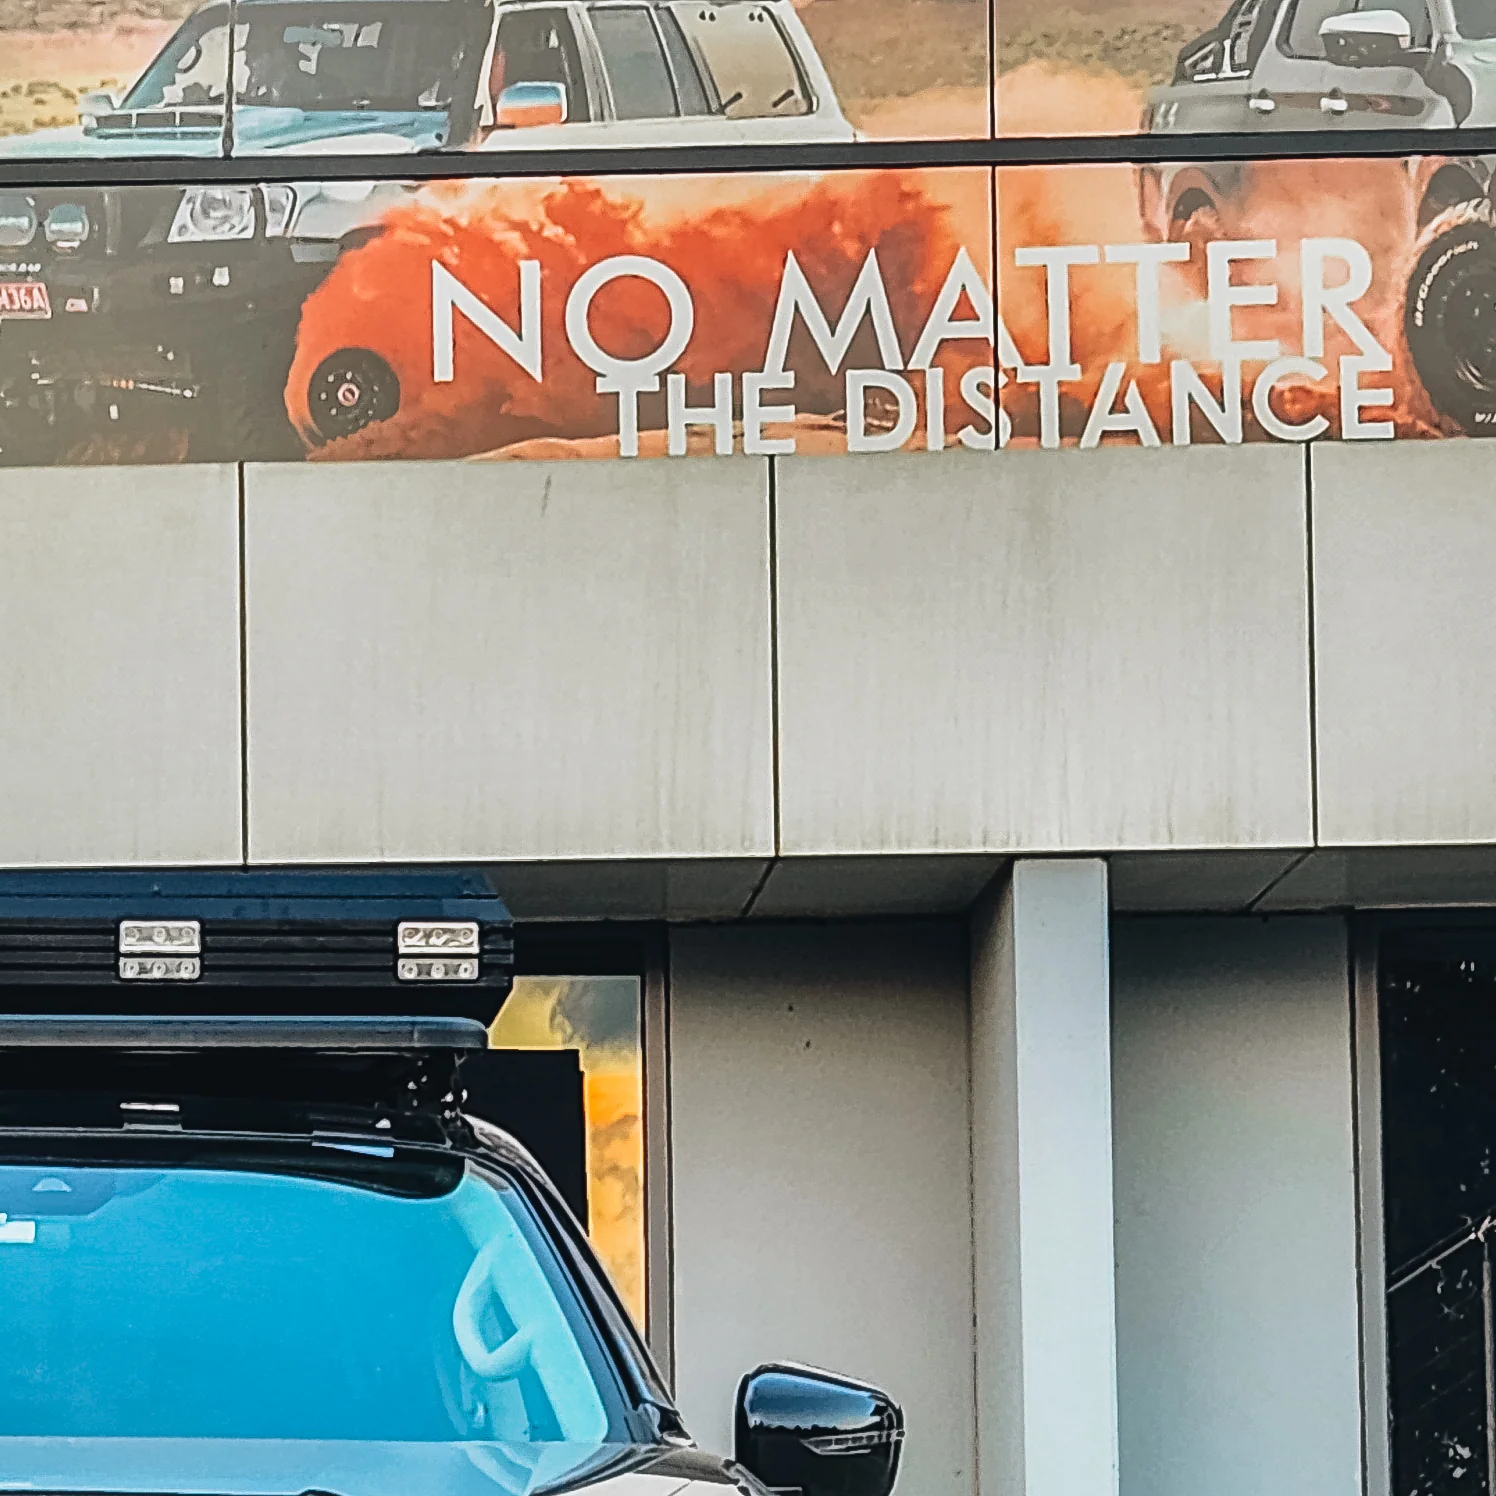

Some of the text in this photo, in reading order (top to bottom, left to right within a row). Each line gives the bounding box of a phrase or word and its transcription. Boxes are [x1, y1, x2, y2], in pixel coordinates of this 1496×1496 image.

[431, 237, 1393, 382] NO MATTER
[595, 355, 1394, 457] THE DISTANCE
